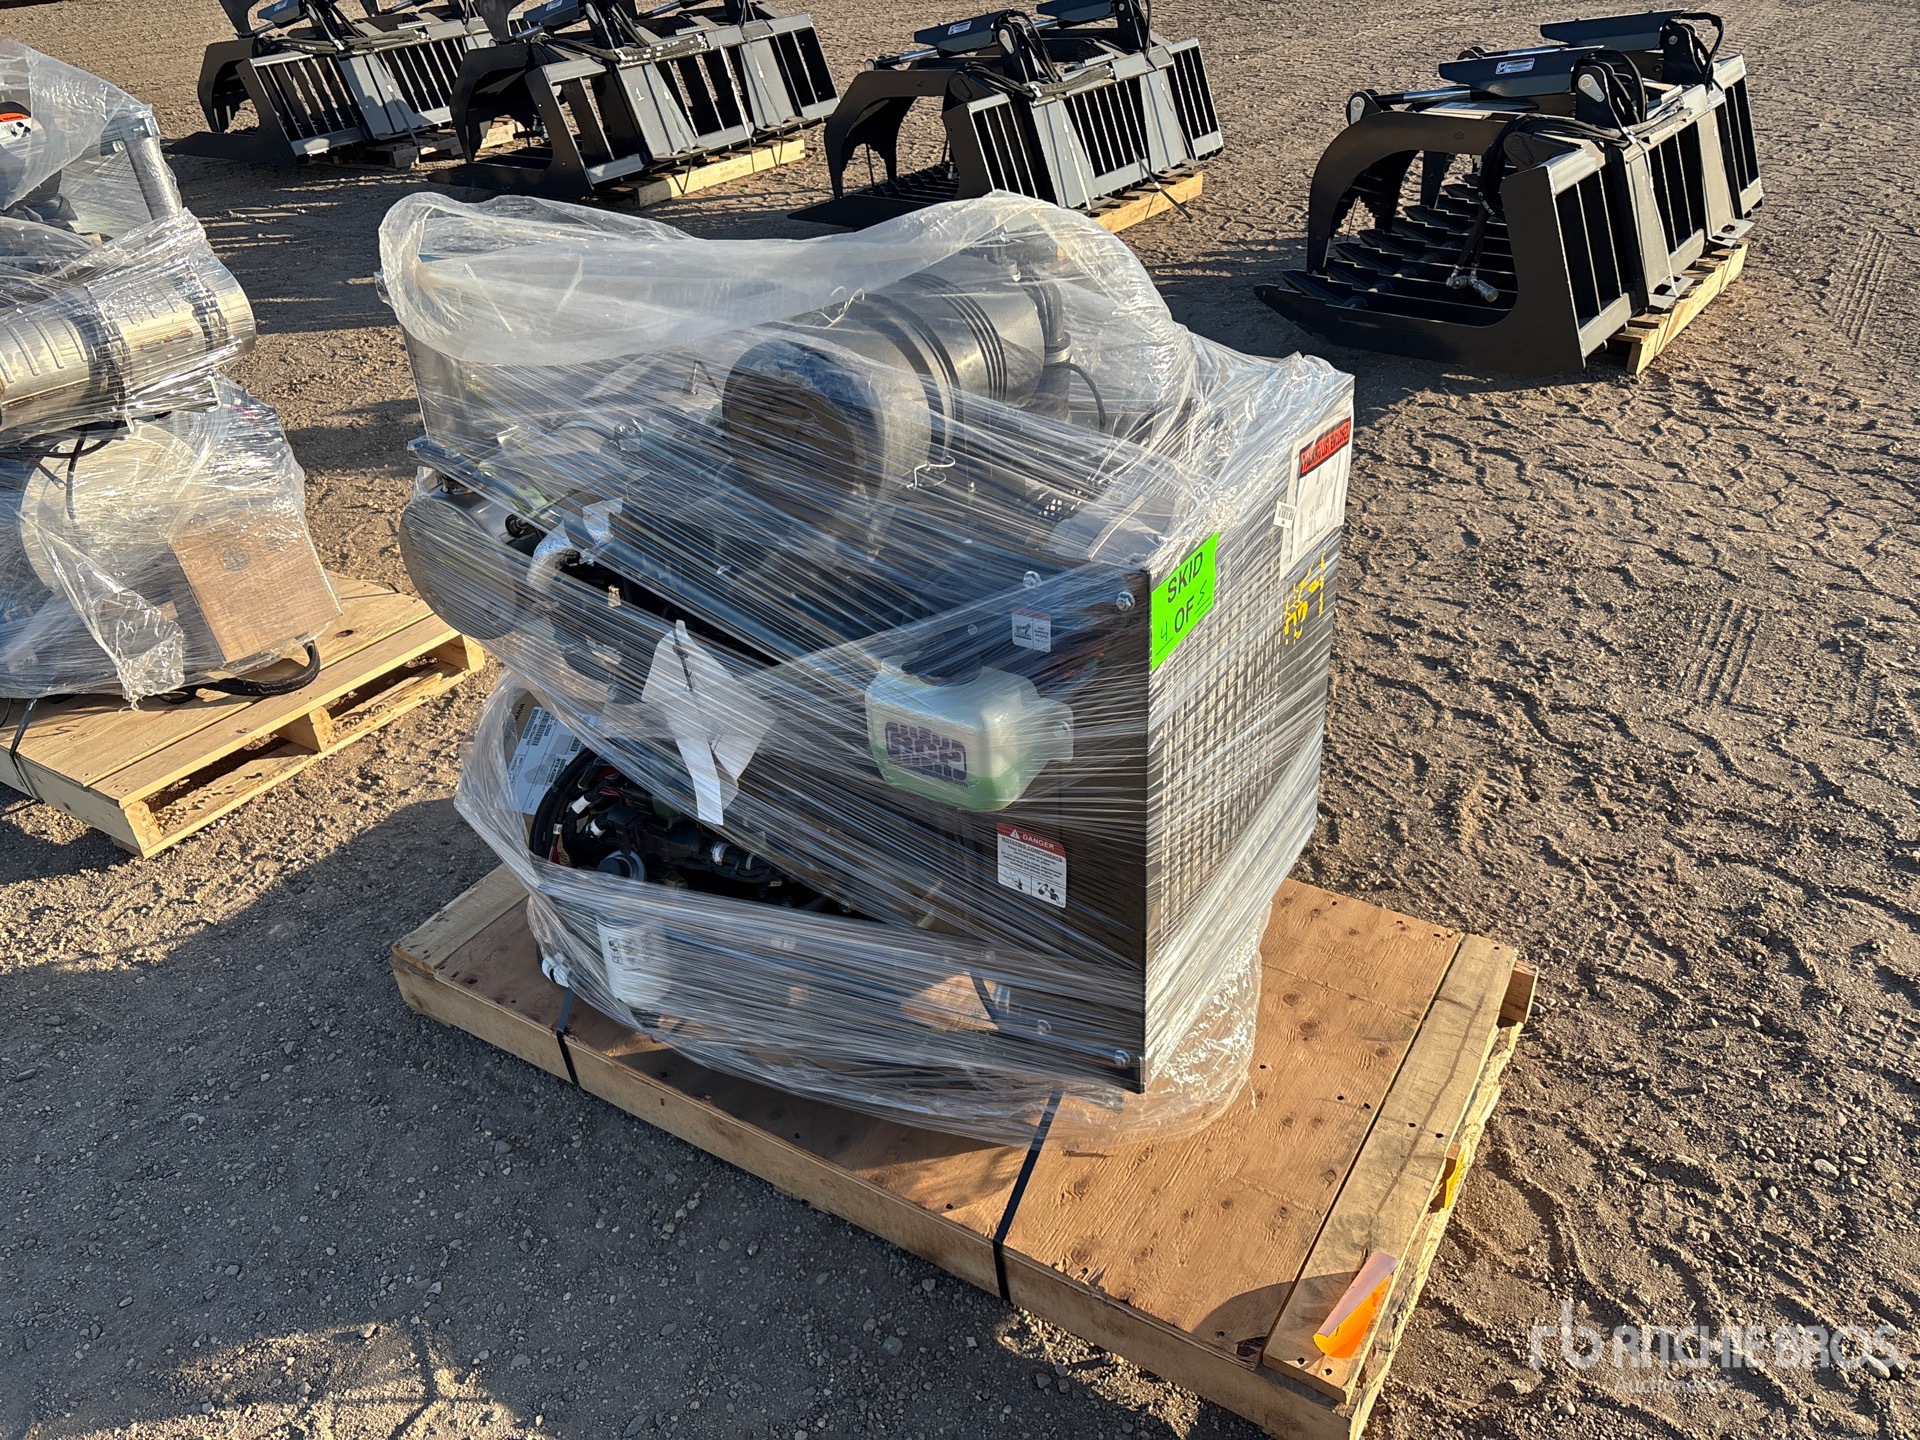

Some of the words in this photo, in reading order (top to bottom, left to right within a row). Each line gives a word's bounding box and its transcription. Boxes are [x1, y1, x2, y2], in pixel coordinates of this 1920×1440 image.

[1167, 552, 1203, 604] SKID
[1160, 620, 1168, 642] 4
[1174, 594, 1195, 634] OF
[1022, 834, 1055, 850] DANGER
[1027, 846, 1062, 863] COMPONENTS
